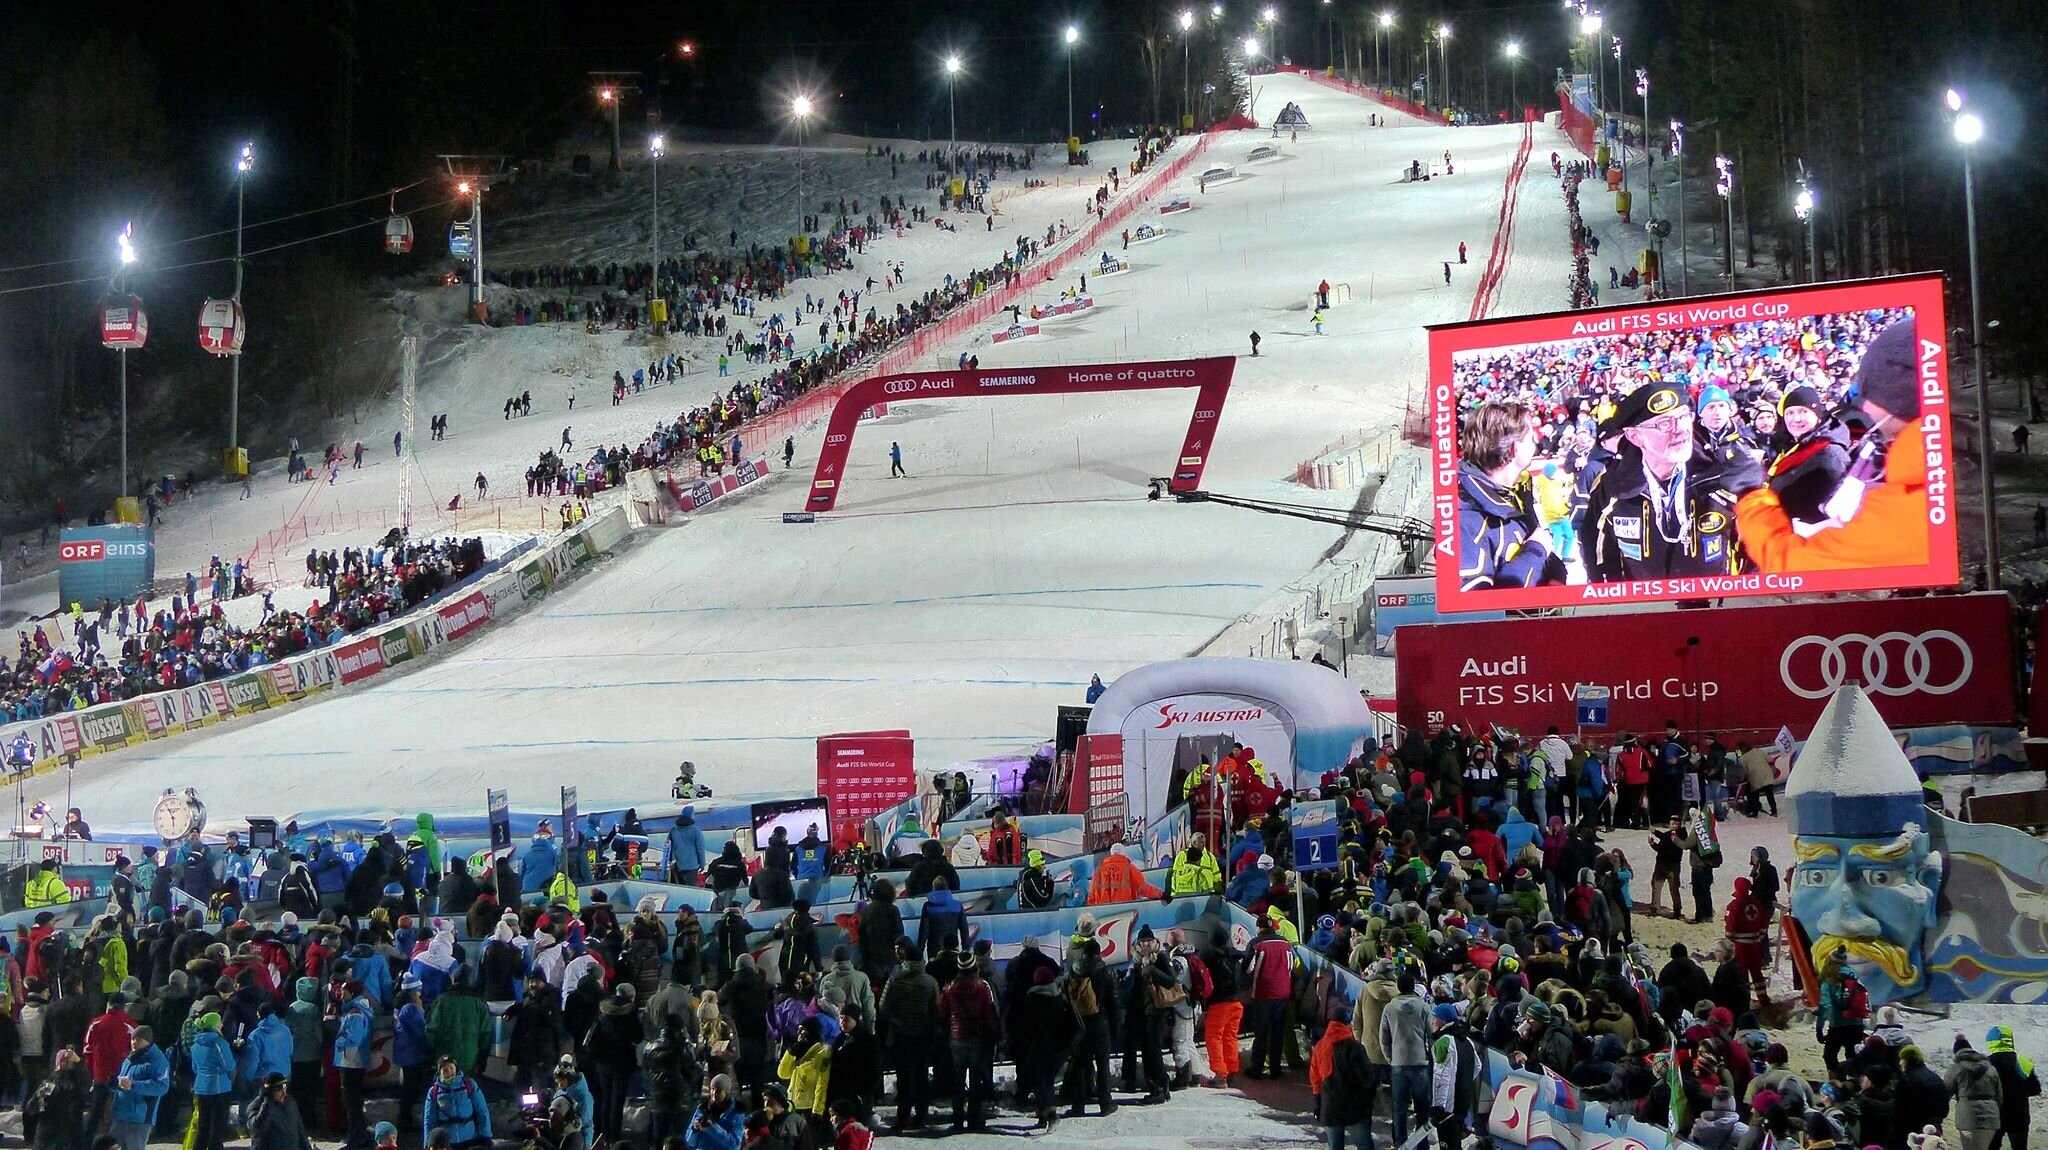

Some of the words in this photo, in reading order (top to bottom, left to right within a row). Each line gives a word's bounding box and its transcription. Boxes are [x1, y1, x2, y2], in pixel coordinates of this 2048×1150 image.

[1572, 319, 1615, 335] Audi
[1621, 314, 1651, 329] FIS
[1657, 311, 1683, 326] Ski
[1687, 305, 1746, 322] World
[1752, 302, 1789, 318] Cup
[1068, 372, 1113, 383] Home
[1117, 369, 1134, 381] of
[1137, 368, 1196, 382] quattro
[1920, 339, 1945, 405] Audi
[920, 378, 954, 389] Audi
[979, 375, 1036, 387] SEMMERING
[1436, 385, 1457, 486] quattro
[1920, 413, 1947, 525] quattro
[739, 472, 758, 485] LATTE
[695, 494, 712, 507] LATTE
[1436, 494, 1454, 557] Audi
[62, 544, 101, 558] ORF
[106, 543, 146, 556] eins
[1582, 583, 1626, 598] Audi
[1632, 581, 1663, 596] FIS
[1668, 579, 1695, 594] Ski
[1700, 576, 1760, 592] World
[1766, 574, 1803, 590] Cup
[1380, 597, 1405, 605] ORF
[1409, 594, 1434, 605] eins
[1460, 656, 1527, 677] Audi
[1459, 686, 1504, 706] FIS
[1514, 683, 1553, 704] Ski
[1662, 678, 1719, 702] Cup
[1190, 709, 1262, 723] AUSTRIA
[1428, 710, 1444, 723] 50
[1588, 708, 1595, 722] 4
[80, 710, 125, 747] Gösser
[1311, 841, 1320, 861] 2
